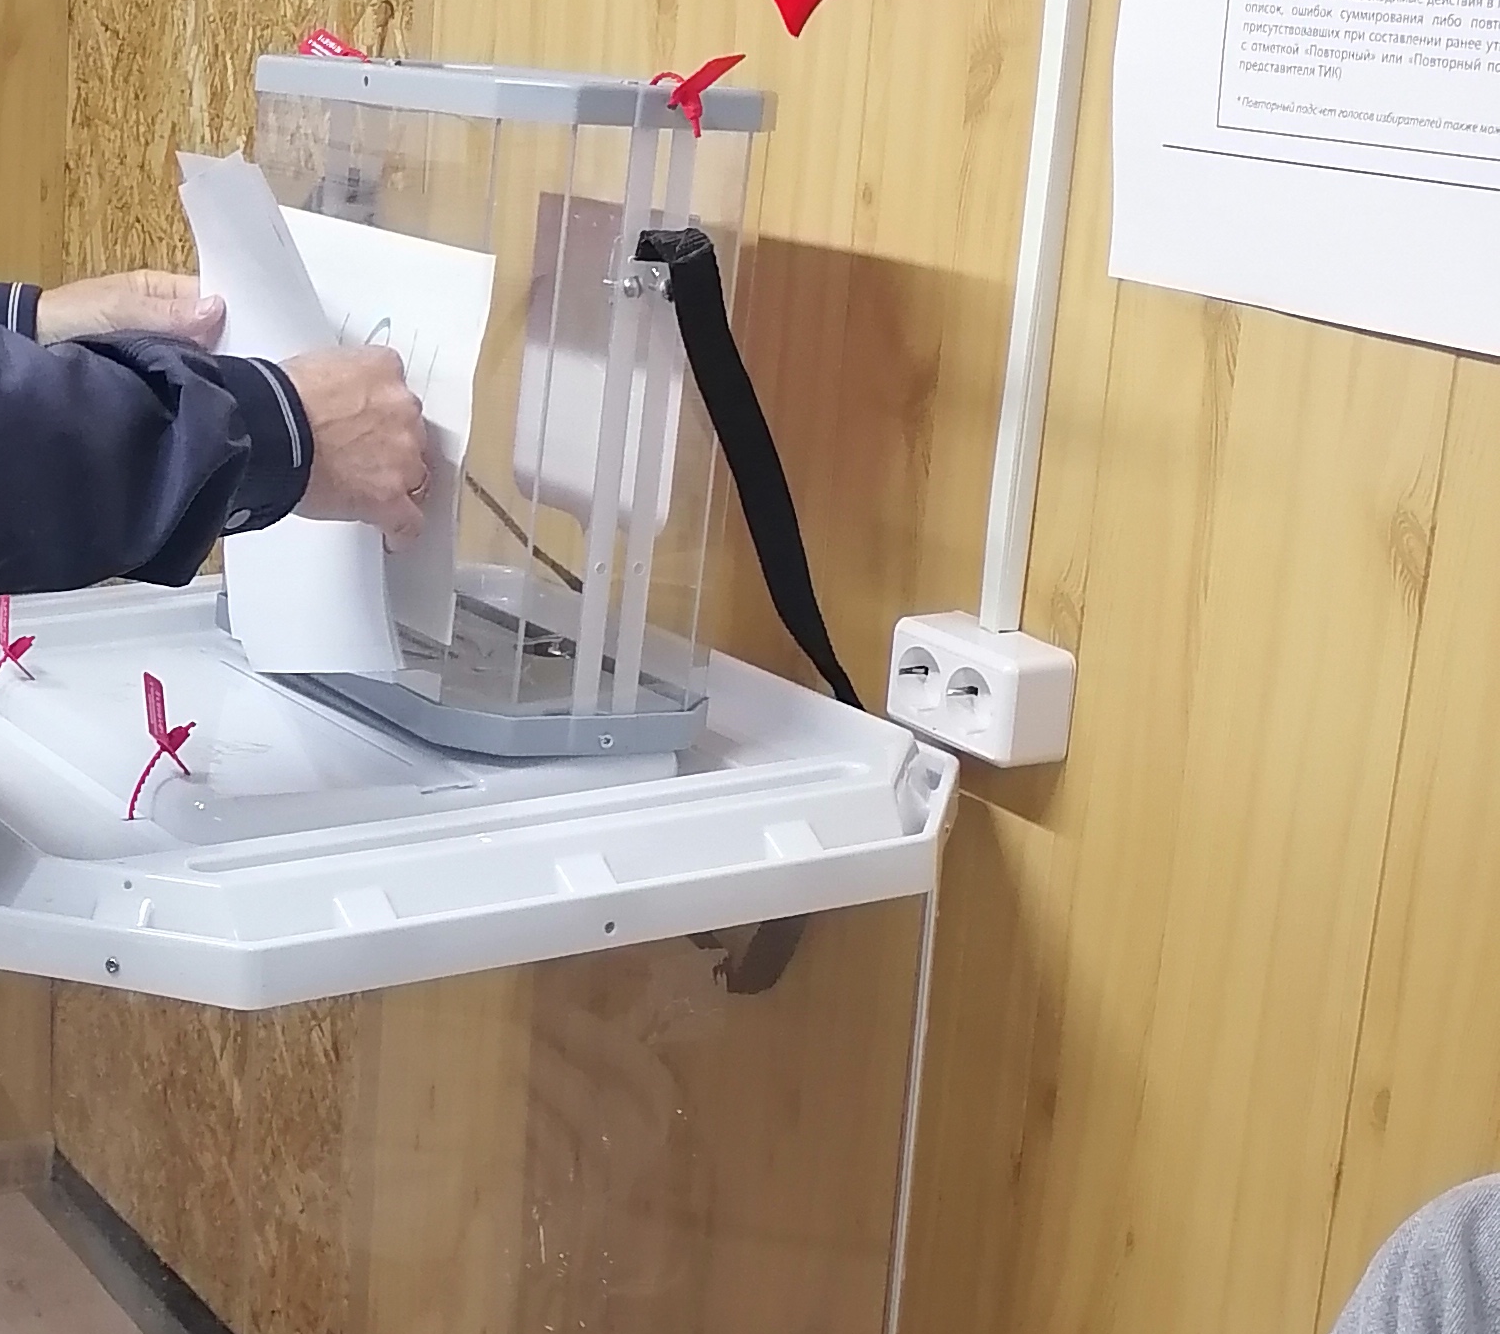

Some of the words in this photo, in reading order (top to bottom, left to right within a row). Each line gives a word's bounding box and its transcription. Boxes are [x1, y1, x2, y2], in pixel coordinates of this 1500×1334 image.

[1292, 5, 1332, 18] ошибок
[1340, 9, 1423, 24] суммирования
[1432, 14, 1461, 27] либо
[1243, 22, 1340, 39] присутствовавших
[1344, 30, 1365, 43] при
[1368, 31, 1441, 46] составлении
[1446, 36, 1481, 50] ранее
[1251, 42, 1299, 55] отметкой
[1381, 52, 1402, 64] или
[1239, 60, 1315, 77] представителя
